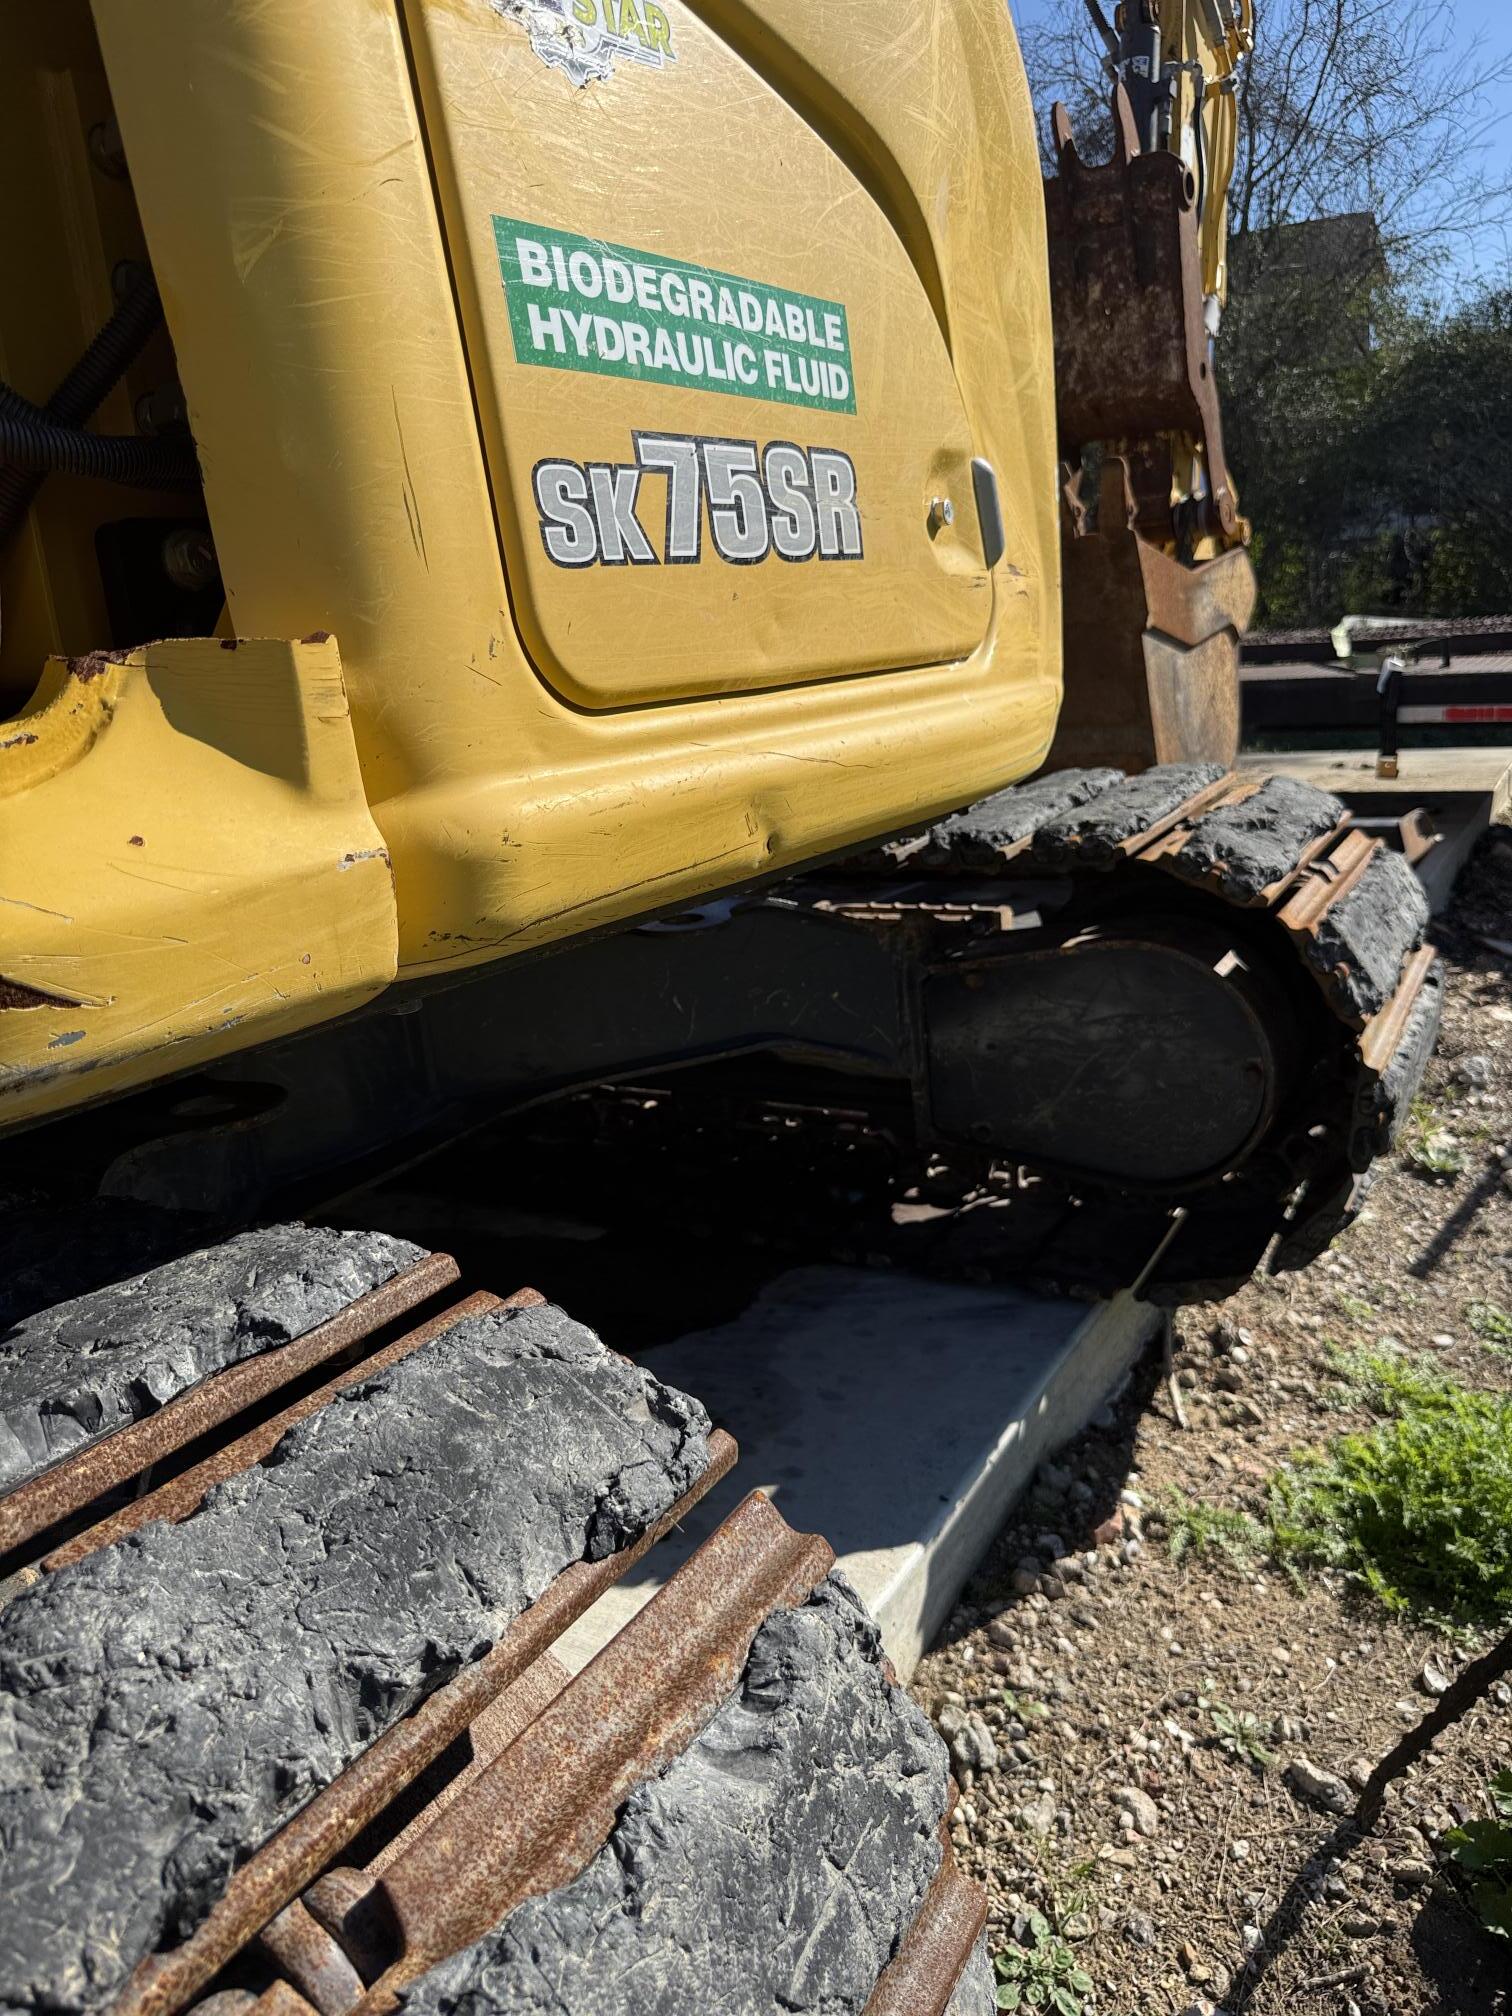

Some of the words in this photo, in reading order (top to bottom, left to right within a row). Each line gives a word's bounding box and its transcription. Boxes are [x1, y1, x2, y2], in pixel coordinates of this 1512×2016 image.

[515, 237, 845, 352] BIODEGRADABLE
[526, 303, 759, 385] HYDRAULIC
[763, 349, 850, 400] FLUID
[532, 430, 864, 568] SK75SR
